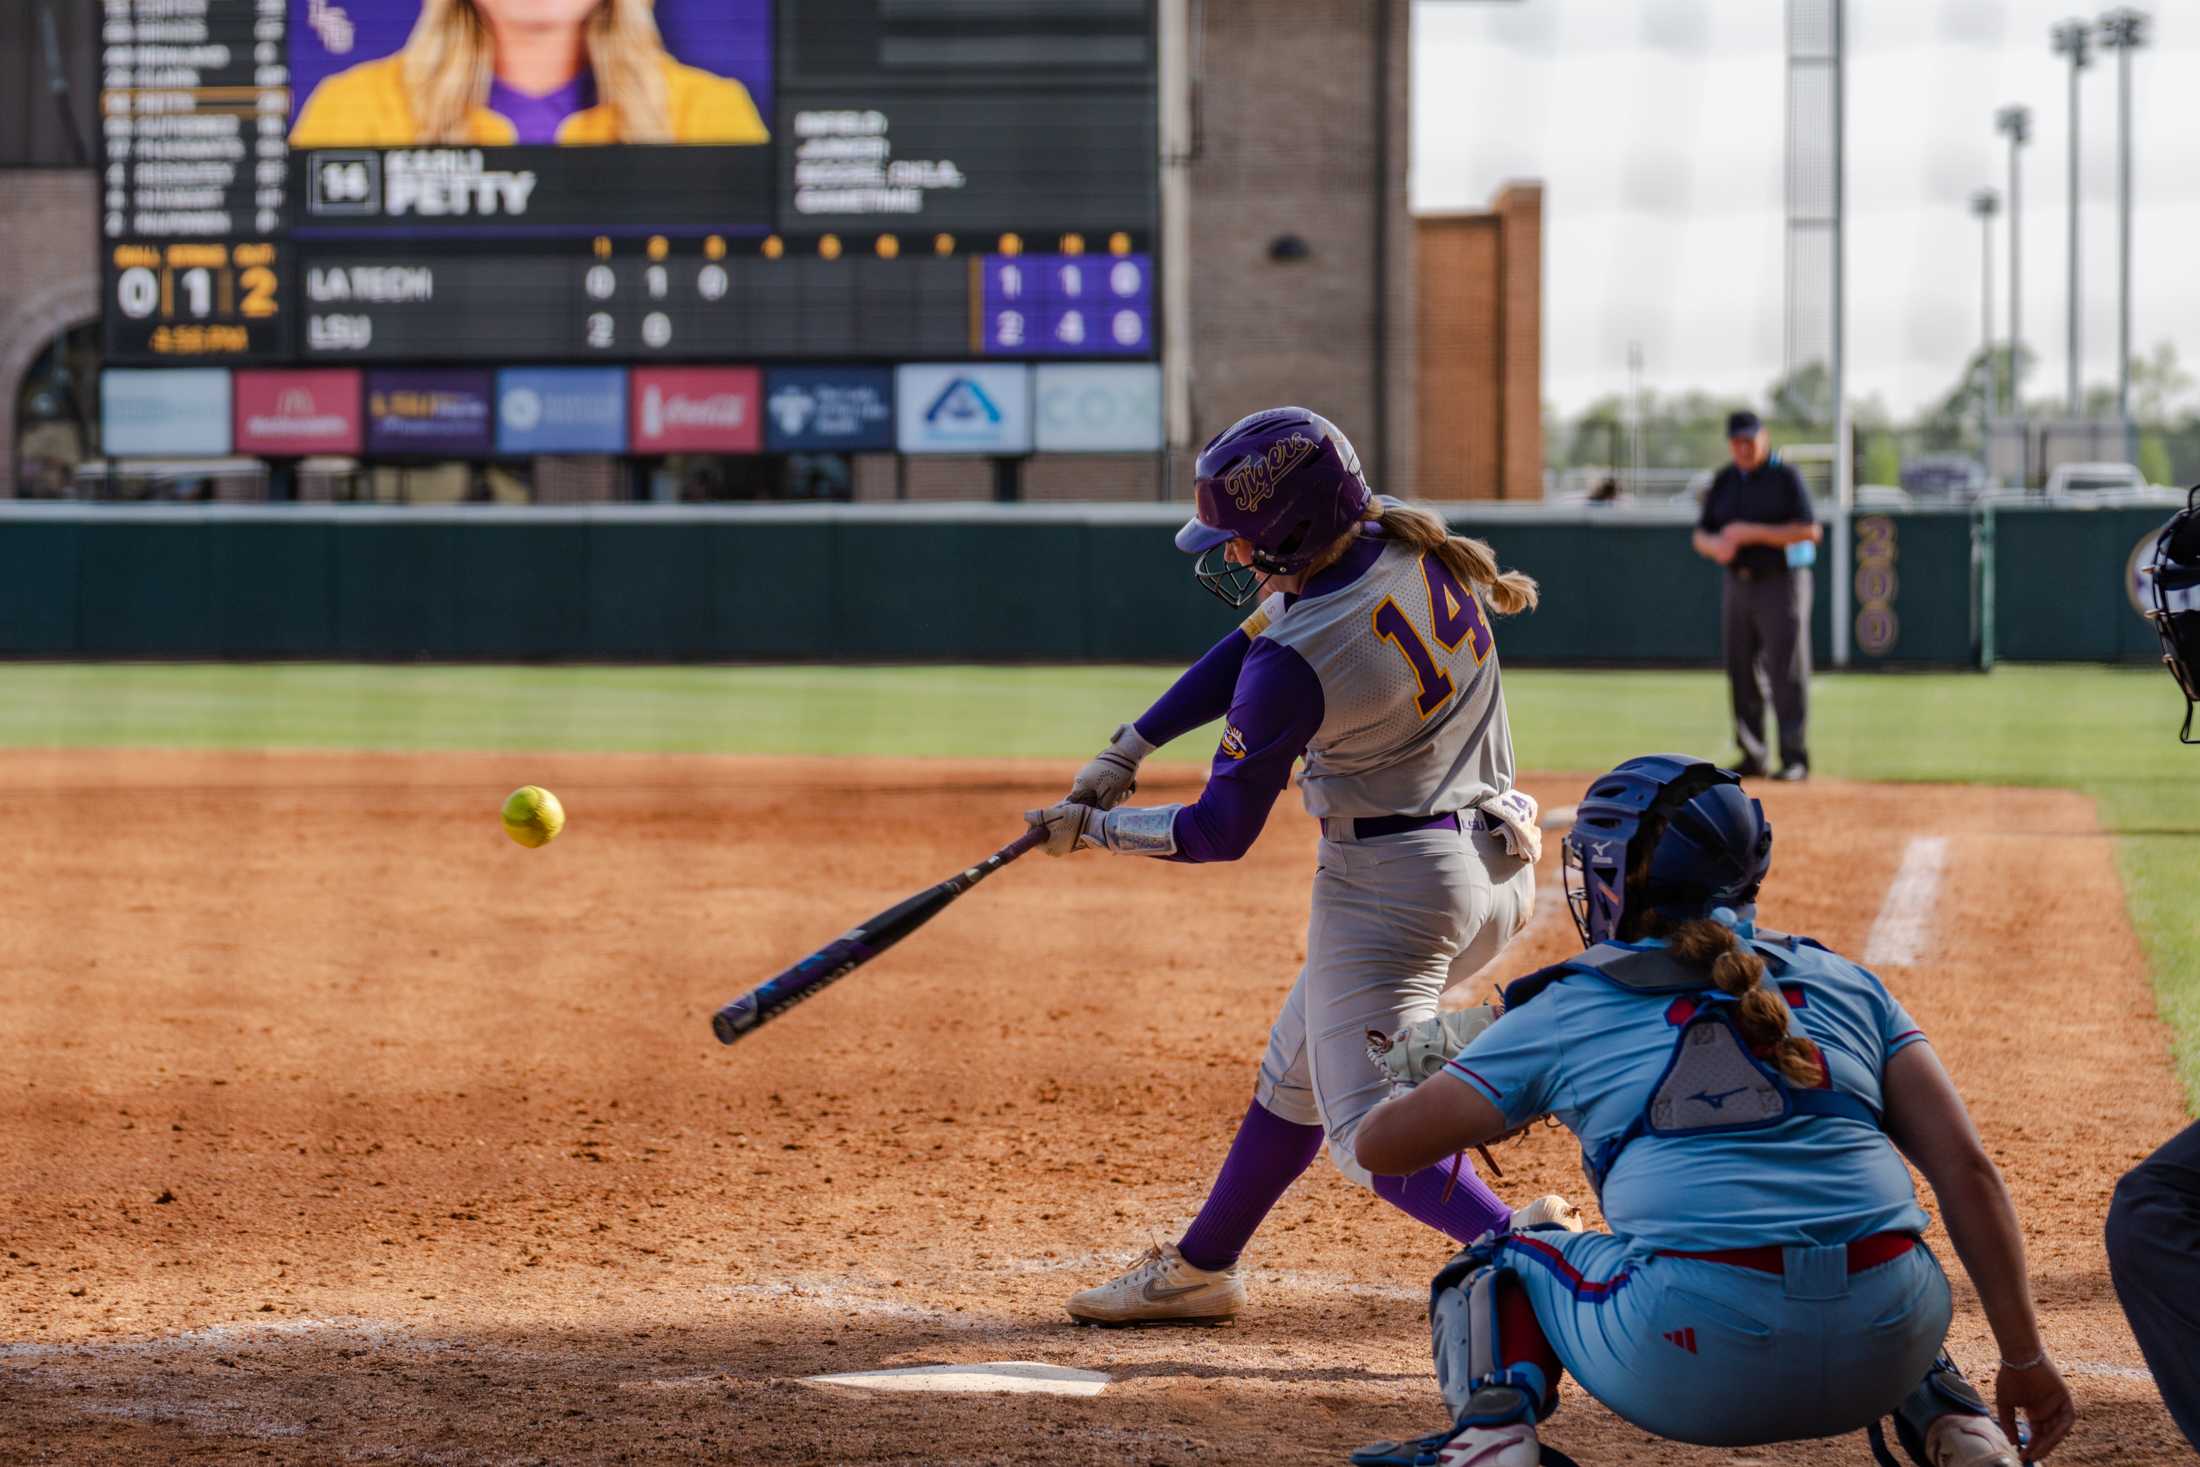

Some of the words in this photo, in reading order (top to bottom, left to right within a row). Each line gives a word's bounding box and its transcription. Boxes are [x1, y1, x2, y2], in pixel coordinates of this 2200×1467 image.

[386, 171, 536, 216] PETTY
[117, 264, 158, 317] 0
[183, 268, 209, 314] 1
[242, 268, 276, 316] 2
[308, 268, 350, 300] LA
[648, 266, 667, 295] 1
[1002, 266, 1021, 294] 1
[1063, 265, 1081, 294] 1
[308, 315, 371, 348] LSU
[589, 313, 613, 347] 2
[999, 311, 1023, 345] 2
[1060, 311, 1083, 342] 4
[1224, 432, 1319, 512] Tigers
[1371, 550, 1494, 721] 14
